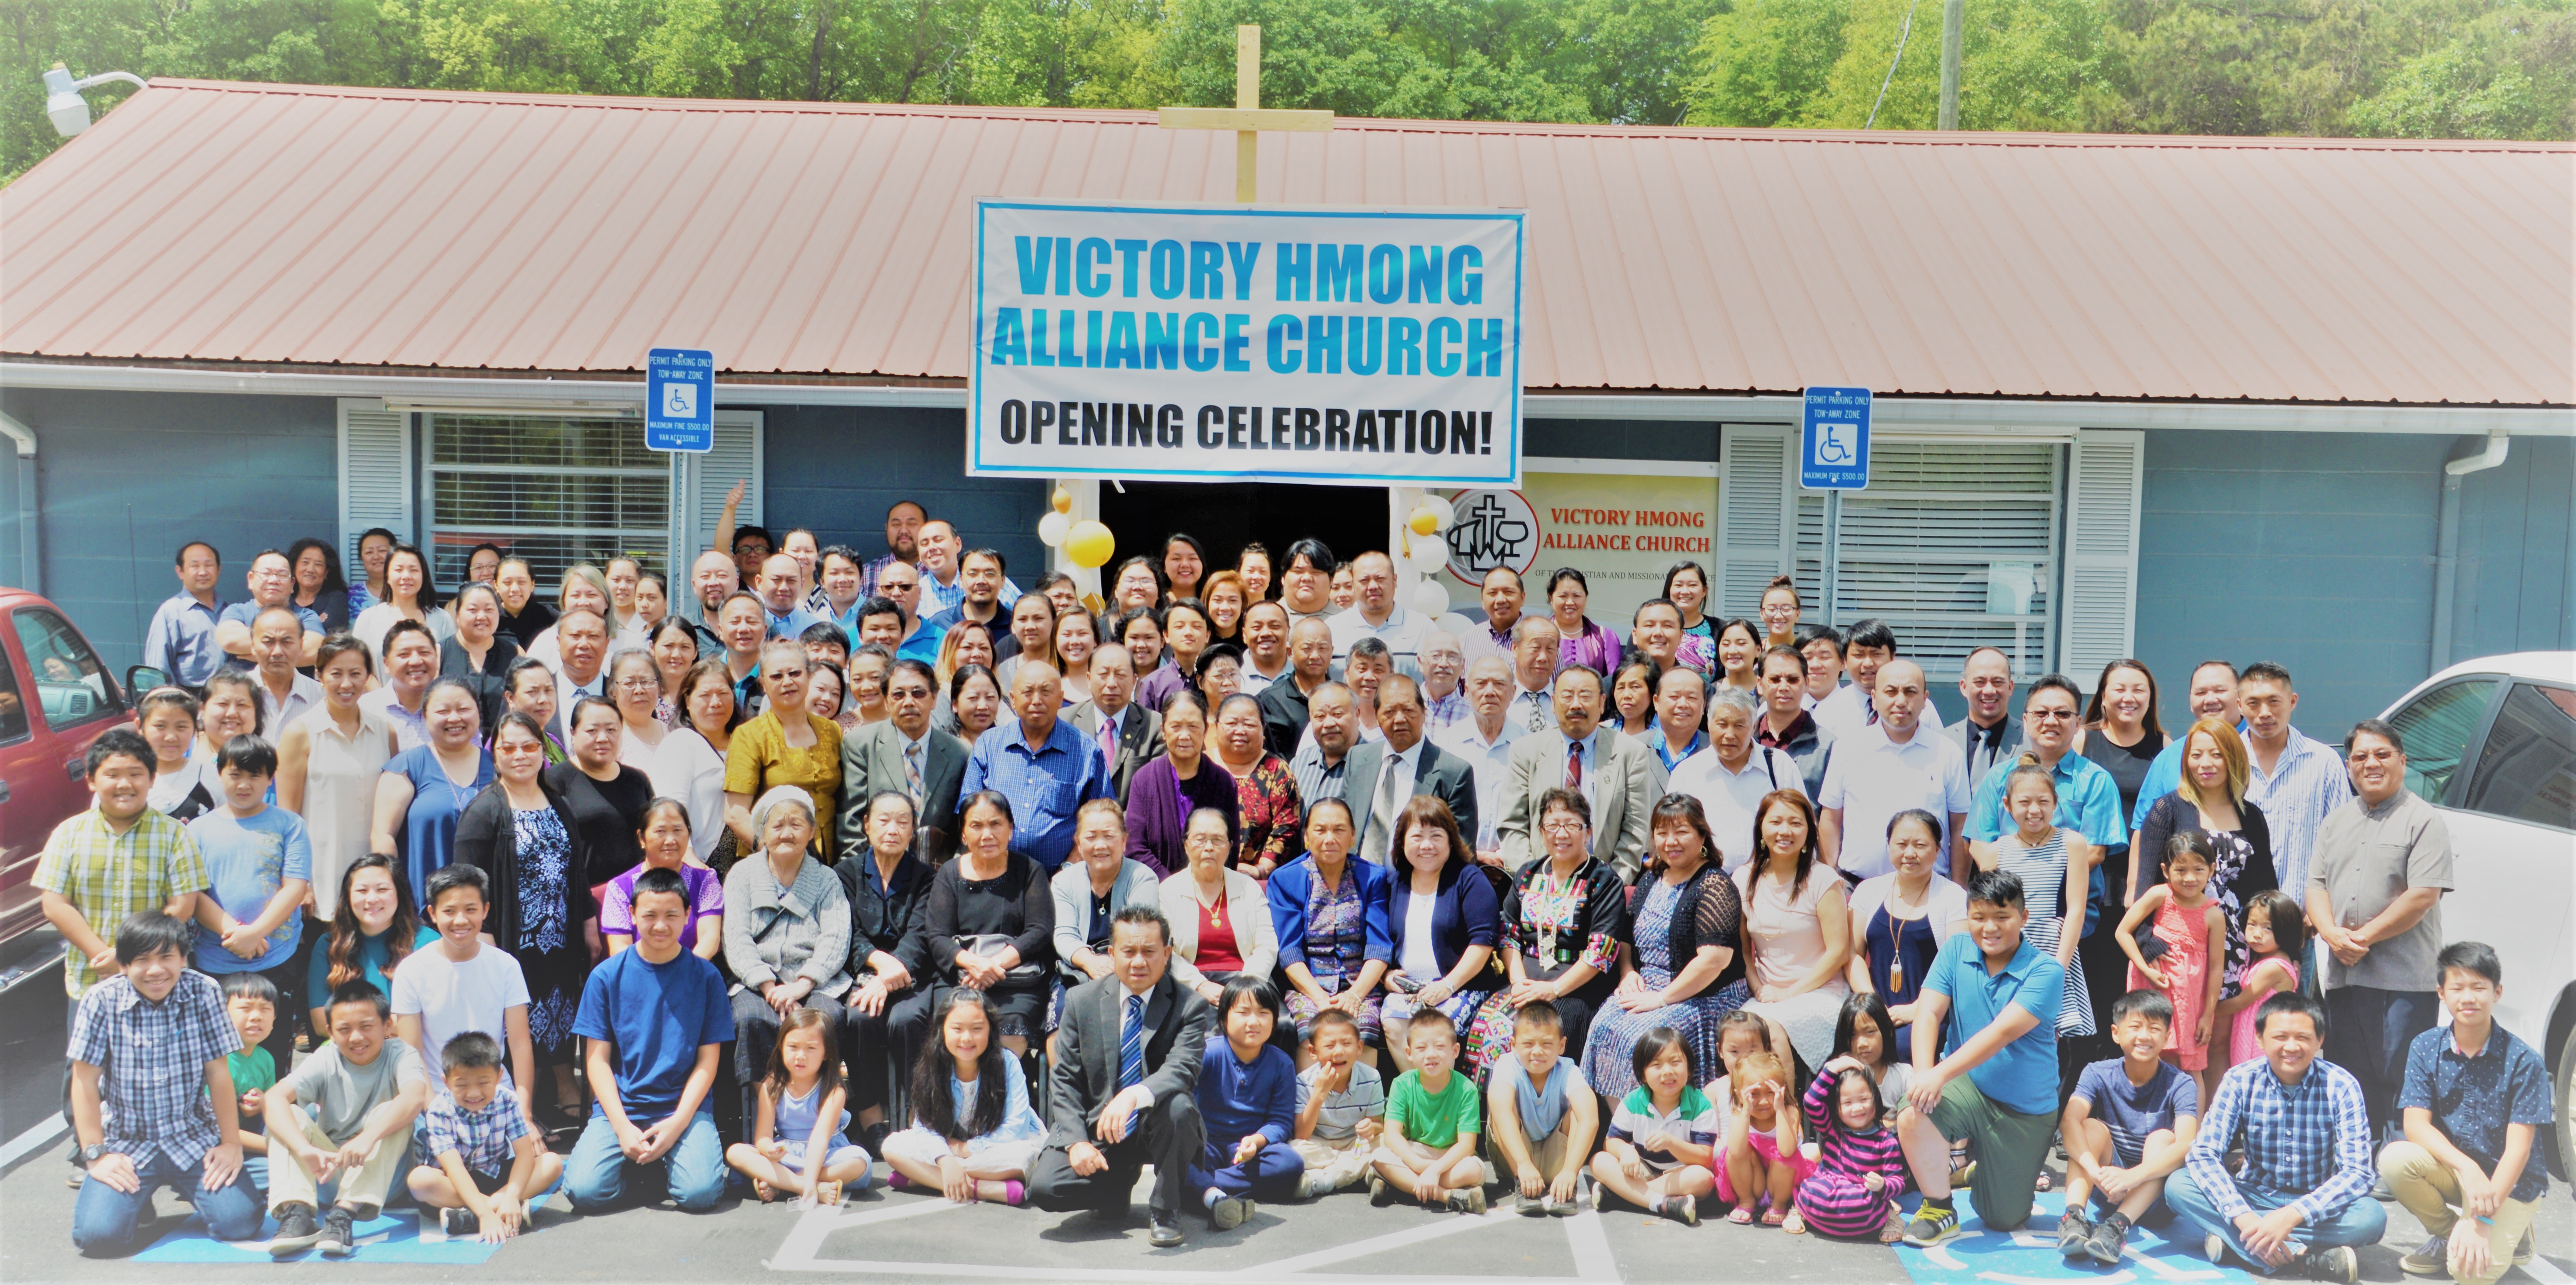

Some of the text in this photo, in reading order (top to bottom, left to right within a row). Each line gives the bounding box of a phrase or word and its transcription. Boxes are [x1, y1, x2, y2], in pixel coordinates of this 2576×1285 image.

[1015, 235, 1483, 305] VICTORY HMONG
[991, 307, 1502, 377] ALLIANCE CHURCH
[650, 356, 712, 367] PERMIT PARKING ONLY
[658, 370, 703, 380] TOW-AWAY ZONE
[1806, 395, 1869, 405] PERMIT PARKING ONLY
[1814, 409, 1860, 419] TOW-AWAY ZONE
[1000, 399, 1492, 455] OPENING CELEBRATION!
[1551, 508, 1704, 527] VICTORY HMONG
[1543, 533, 1710, 552] ALLIANCE CHURCH
